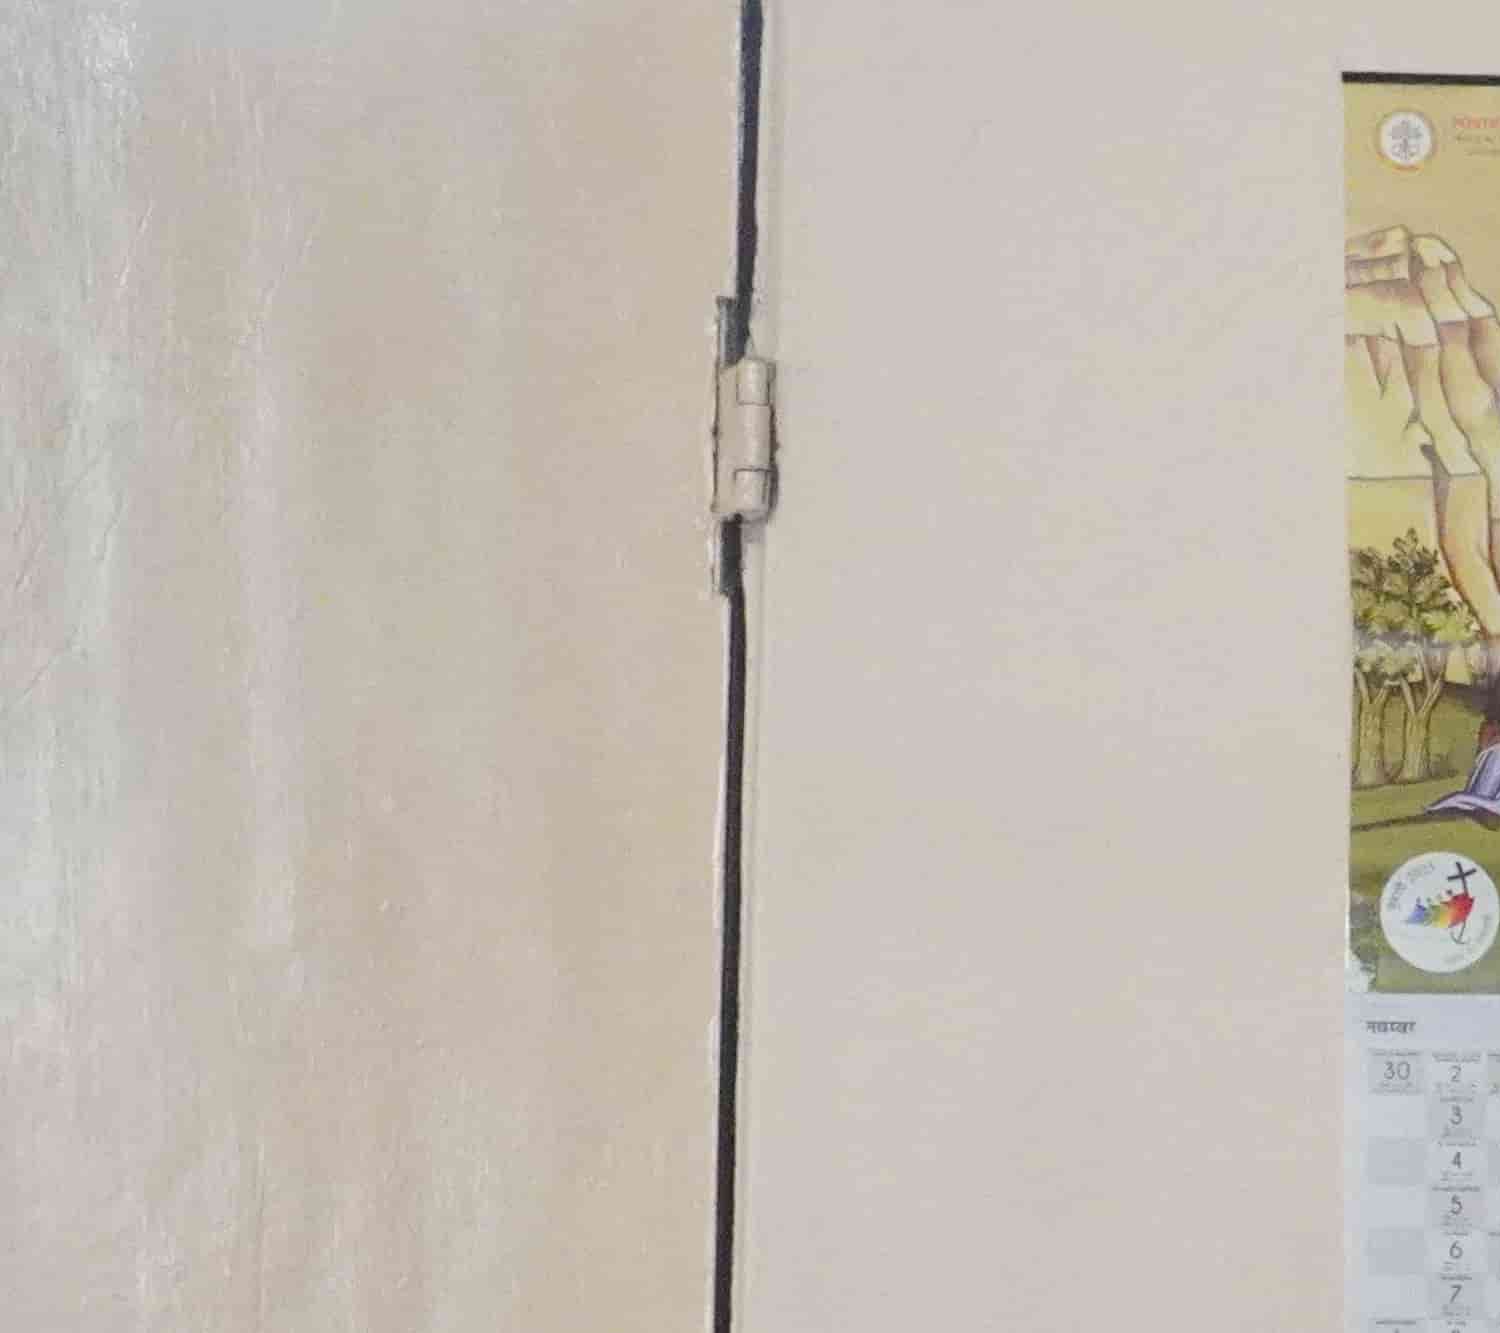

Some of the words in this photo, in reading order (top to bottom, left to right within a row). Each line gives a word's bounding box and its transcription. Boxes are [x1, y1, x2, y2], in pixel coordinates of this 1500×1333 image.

[1384, 1061, 1411, 1081] 30
[1451, 1065, 1462, 1082] 2
[1450, 1106, 1463, 1125] 3
[1451, 1151, 1462, 1169] 4
[1450, 1197, 1463, 1216] 5
[1449, 1241, 1464, 1261] 6
[1450, 1284, 1463, 1302] 7
